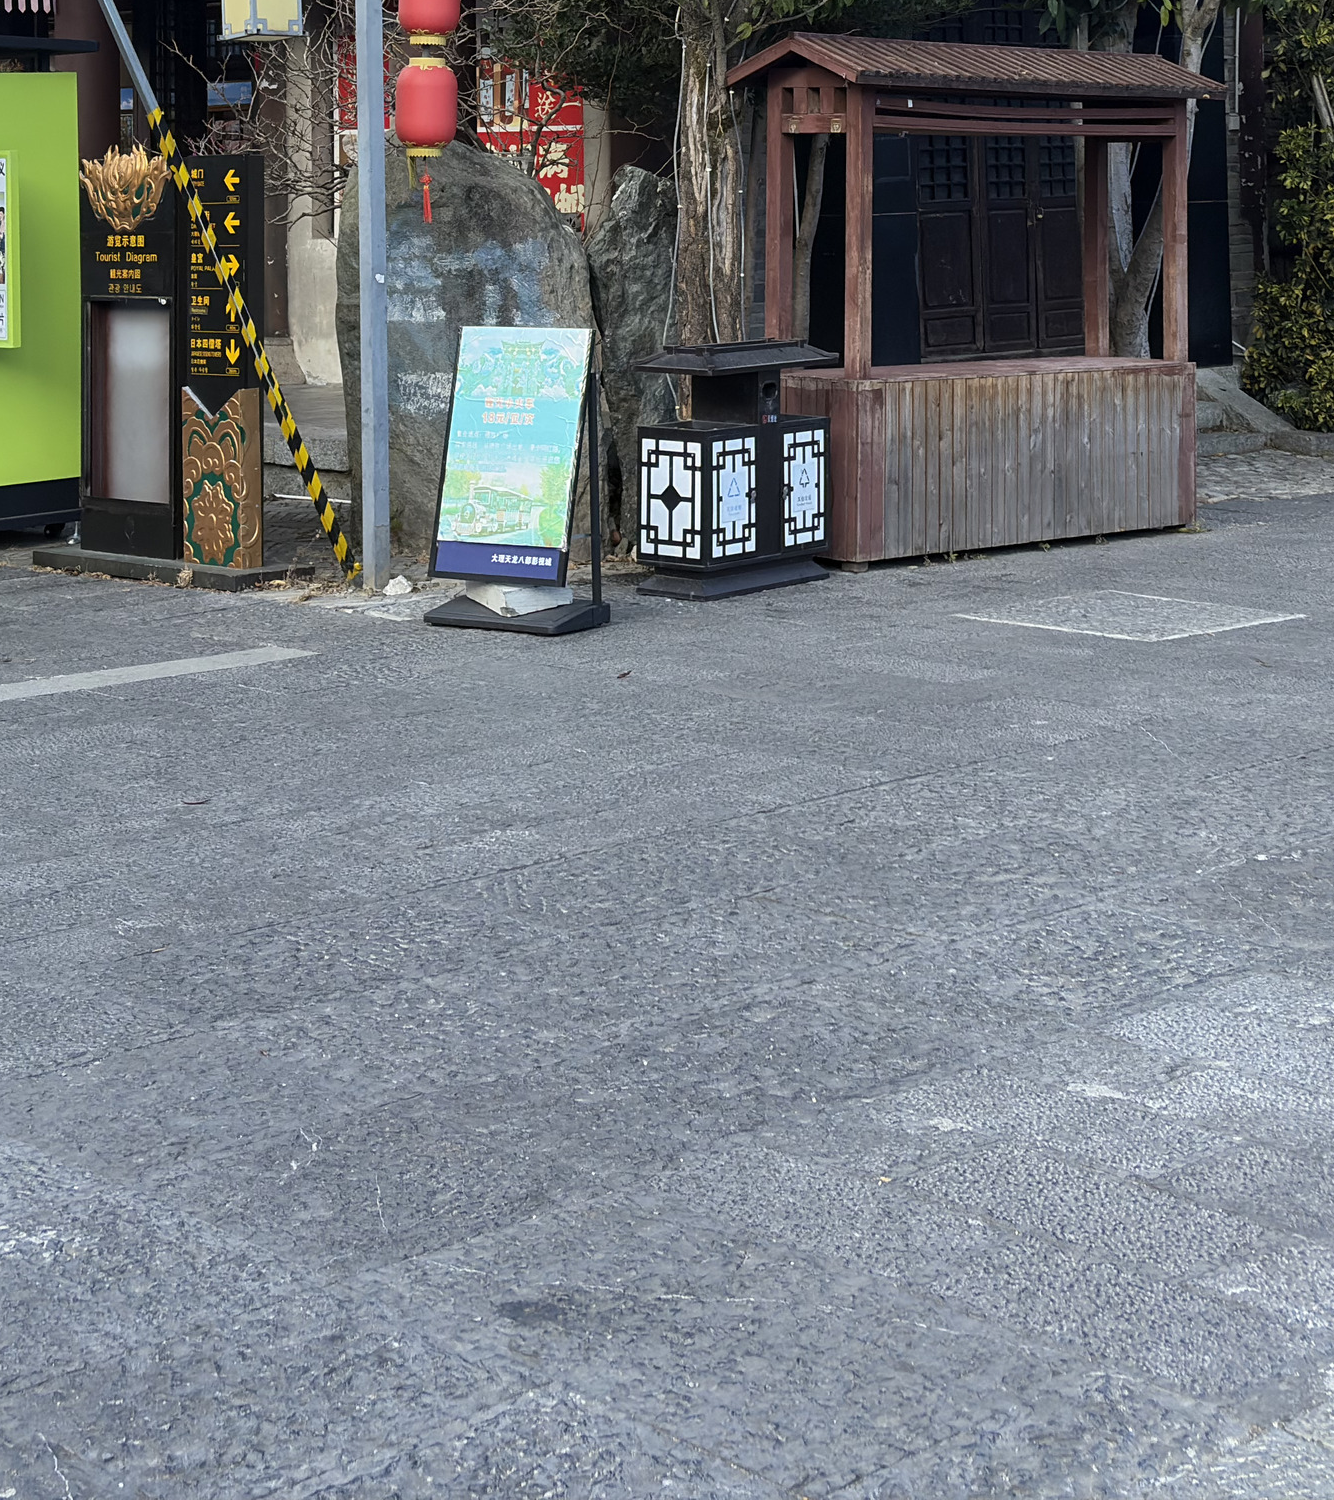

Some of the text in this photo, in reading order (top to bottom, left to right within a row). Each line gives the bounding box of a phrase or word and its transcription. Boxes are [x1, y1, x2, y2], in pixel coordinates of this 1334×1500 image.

[107, 235, 145, 248] 游览示意图
[95, 251, 158, 264] Tourist Diagram
[191, 295, 210, 306] 卫生间
[490, 553, 553, 567] 大理天龙八部影视城
